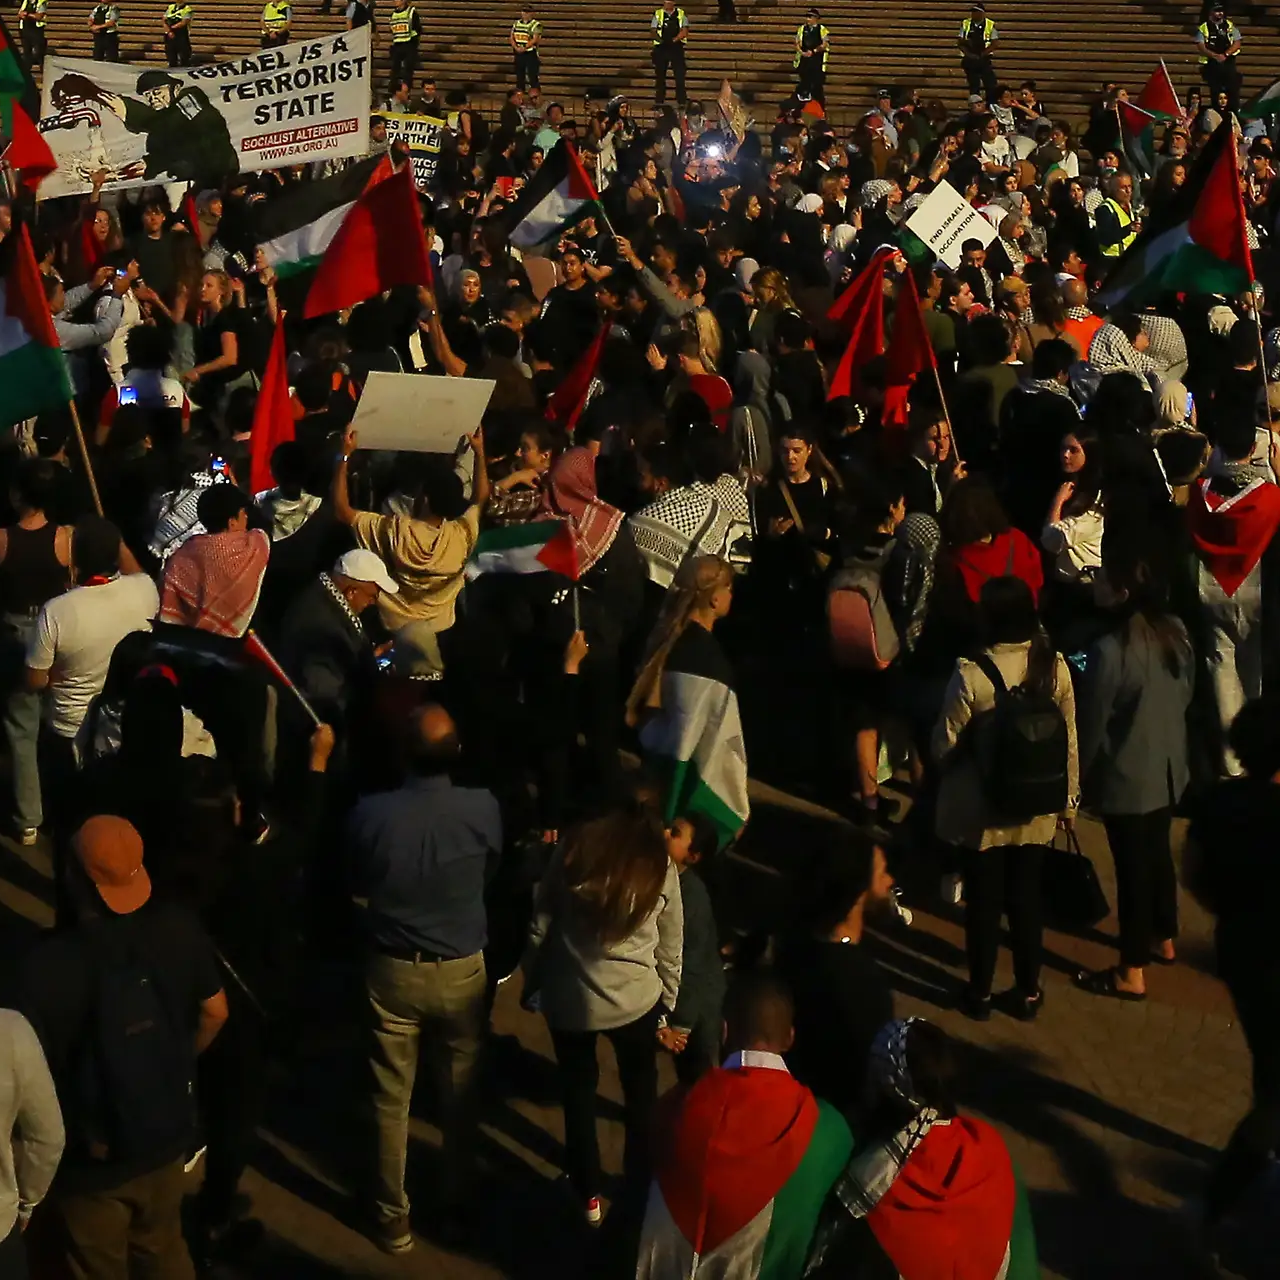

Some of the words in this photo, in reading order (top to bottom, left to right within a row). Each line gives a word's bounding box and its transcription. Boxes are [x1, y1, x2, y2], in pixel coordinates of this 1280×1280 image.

[298, 42, 323, 64] IS
[332, 36, 349, 54] A
[220, 56, 367, 103] TERRORIST
[254, 91, 335, 125] STATE
[243, 131, 294, 150] SOCIALIST
[295, 120, 356, 140] ALTERNATIVE
[405, 121, 437, 134] WITH
[929, 228, 943, 244] END
[942, 203, 965, 230] ISRAELI
[938, 211, 976, 254] OCCUPATION
